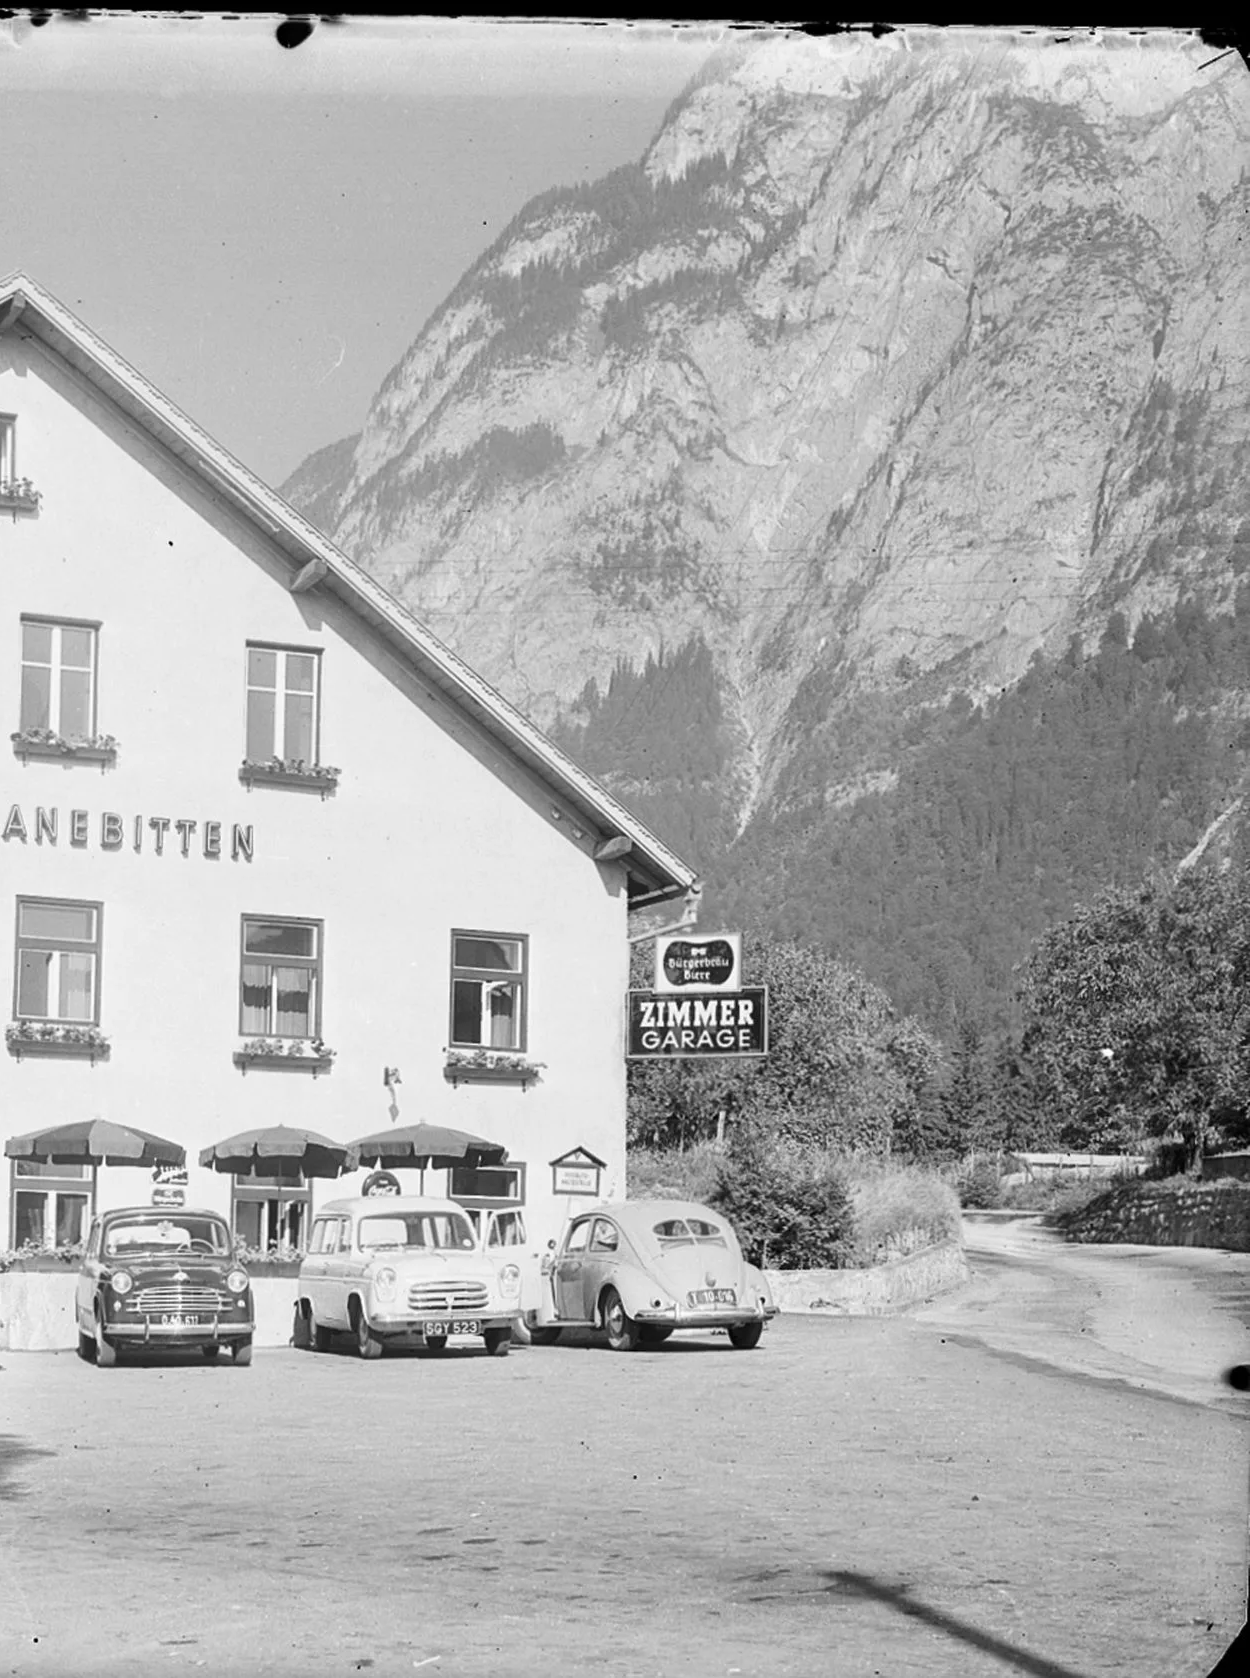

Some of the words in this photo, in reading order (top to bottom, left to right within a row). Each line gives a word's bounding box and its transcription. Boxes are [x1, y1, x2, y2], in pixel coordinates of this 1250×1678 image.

[684, 970, 711, 980] Biere
[639, 1000, 754, 1028] ZIMMER
[641, 1028, 751, 1049] GARAGE
[426, 1322, 450, 1335] SGY
[453, 1321, 478, 1334] 523
